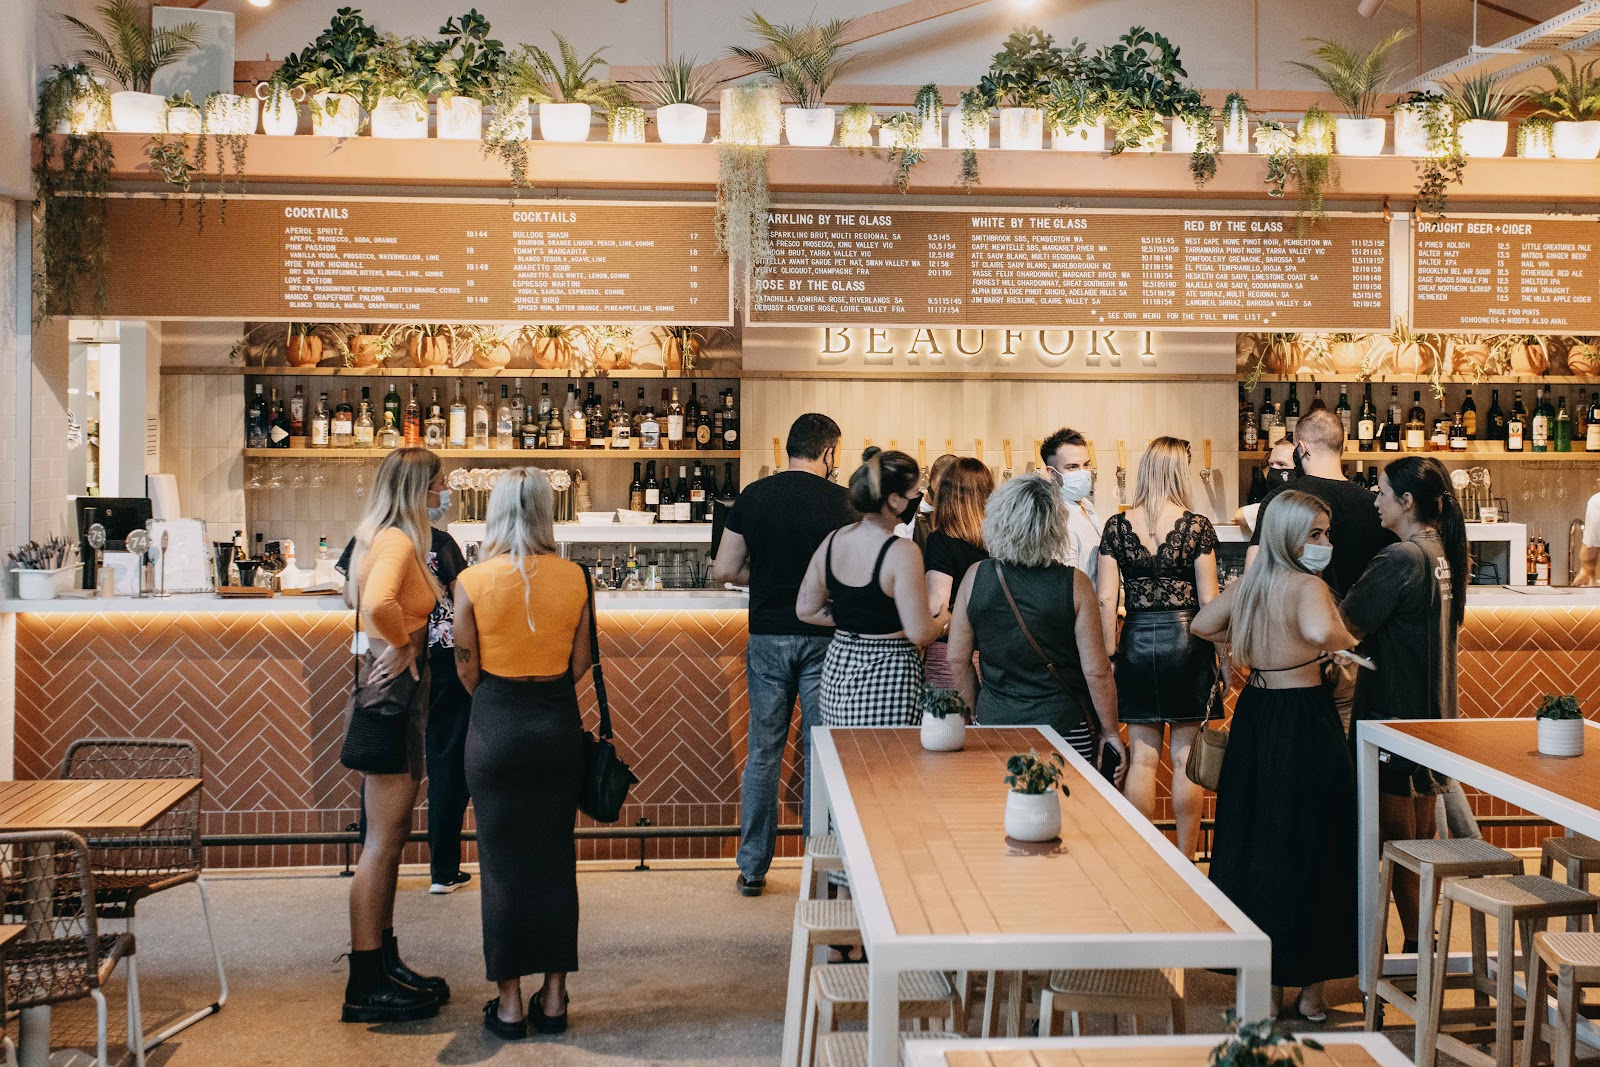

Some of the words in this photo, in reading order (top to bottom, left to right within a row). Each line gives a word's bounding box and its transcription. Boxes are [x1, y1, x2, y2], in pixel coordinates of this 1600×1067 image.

[285, 207, 348, 219] COCKTAILS
[513, 212, 576, 223] COCKTAILS
[818, 214, 830, 225] BY
[836, 214, 855, 225] THE
[859, 215, 891, 226] GLASS
[972, 217, 1005, 228] WHITE
[1011, 218, 1023, 228] BY
[1030, 218, 1050, 229] THE
[1053, 219, 1087, 229] GLASS
[1184, 220, 1204, 231] RED
[1210, 221, 1222, 231] BY
[1227, 221, 1246, 232] THE
[1251, 222, 1283, 232] GLASS
[1467, 223, 1493, 234] BEER
[1502, 224, 1531, 235] CIDER
[755, 280, 784, 290] ROSE
[789, 280, 802, 291] BY
[808, 280, 828, 291] THE
[832, 281, 865, 291] GLASS
[555, 476, 567, 485] 82
[1472, 472, 1484, 482] 52
[92, 530, 103, 542] 75
[131, 536, 148, 548] 74
